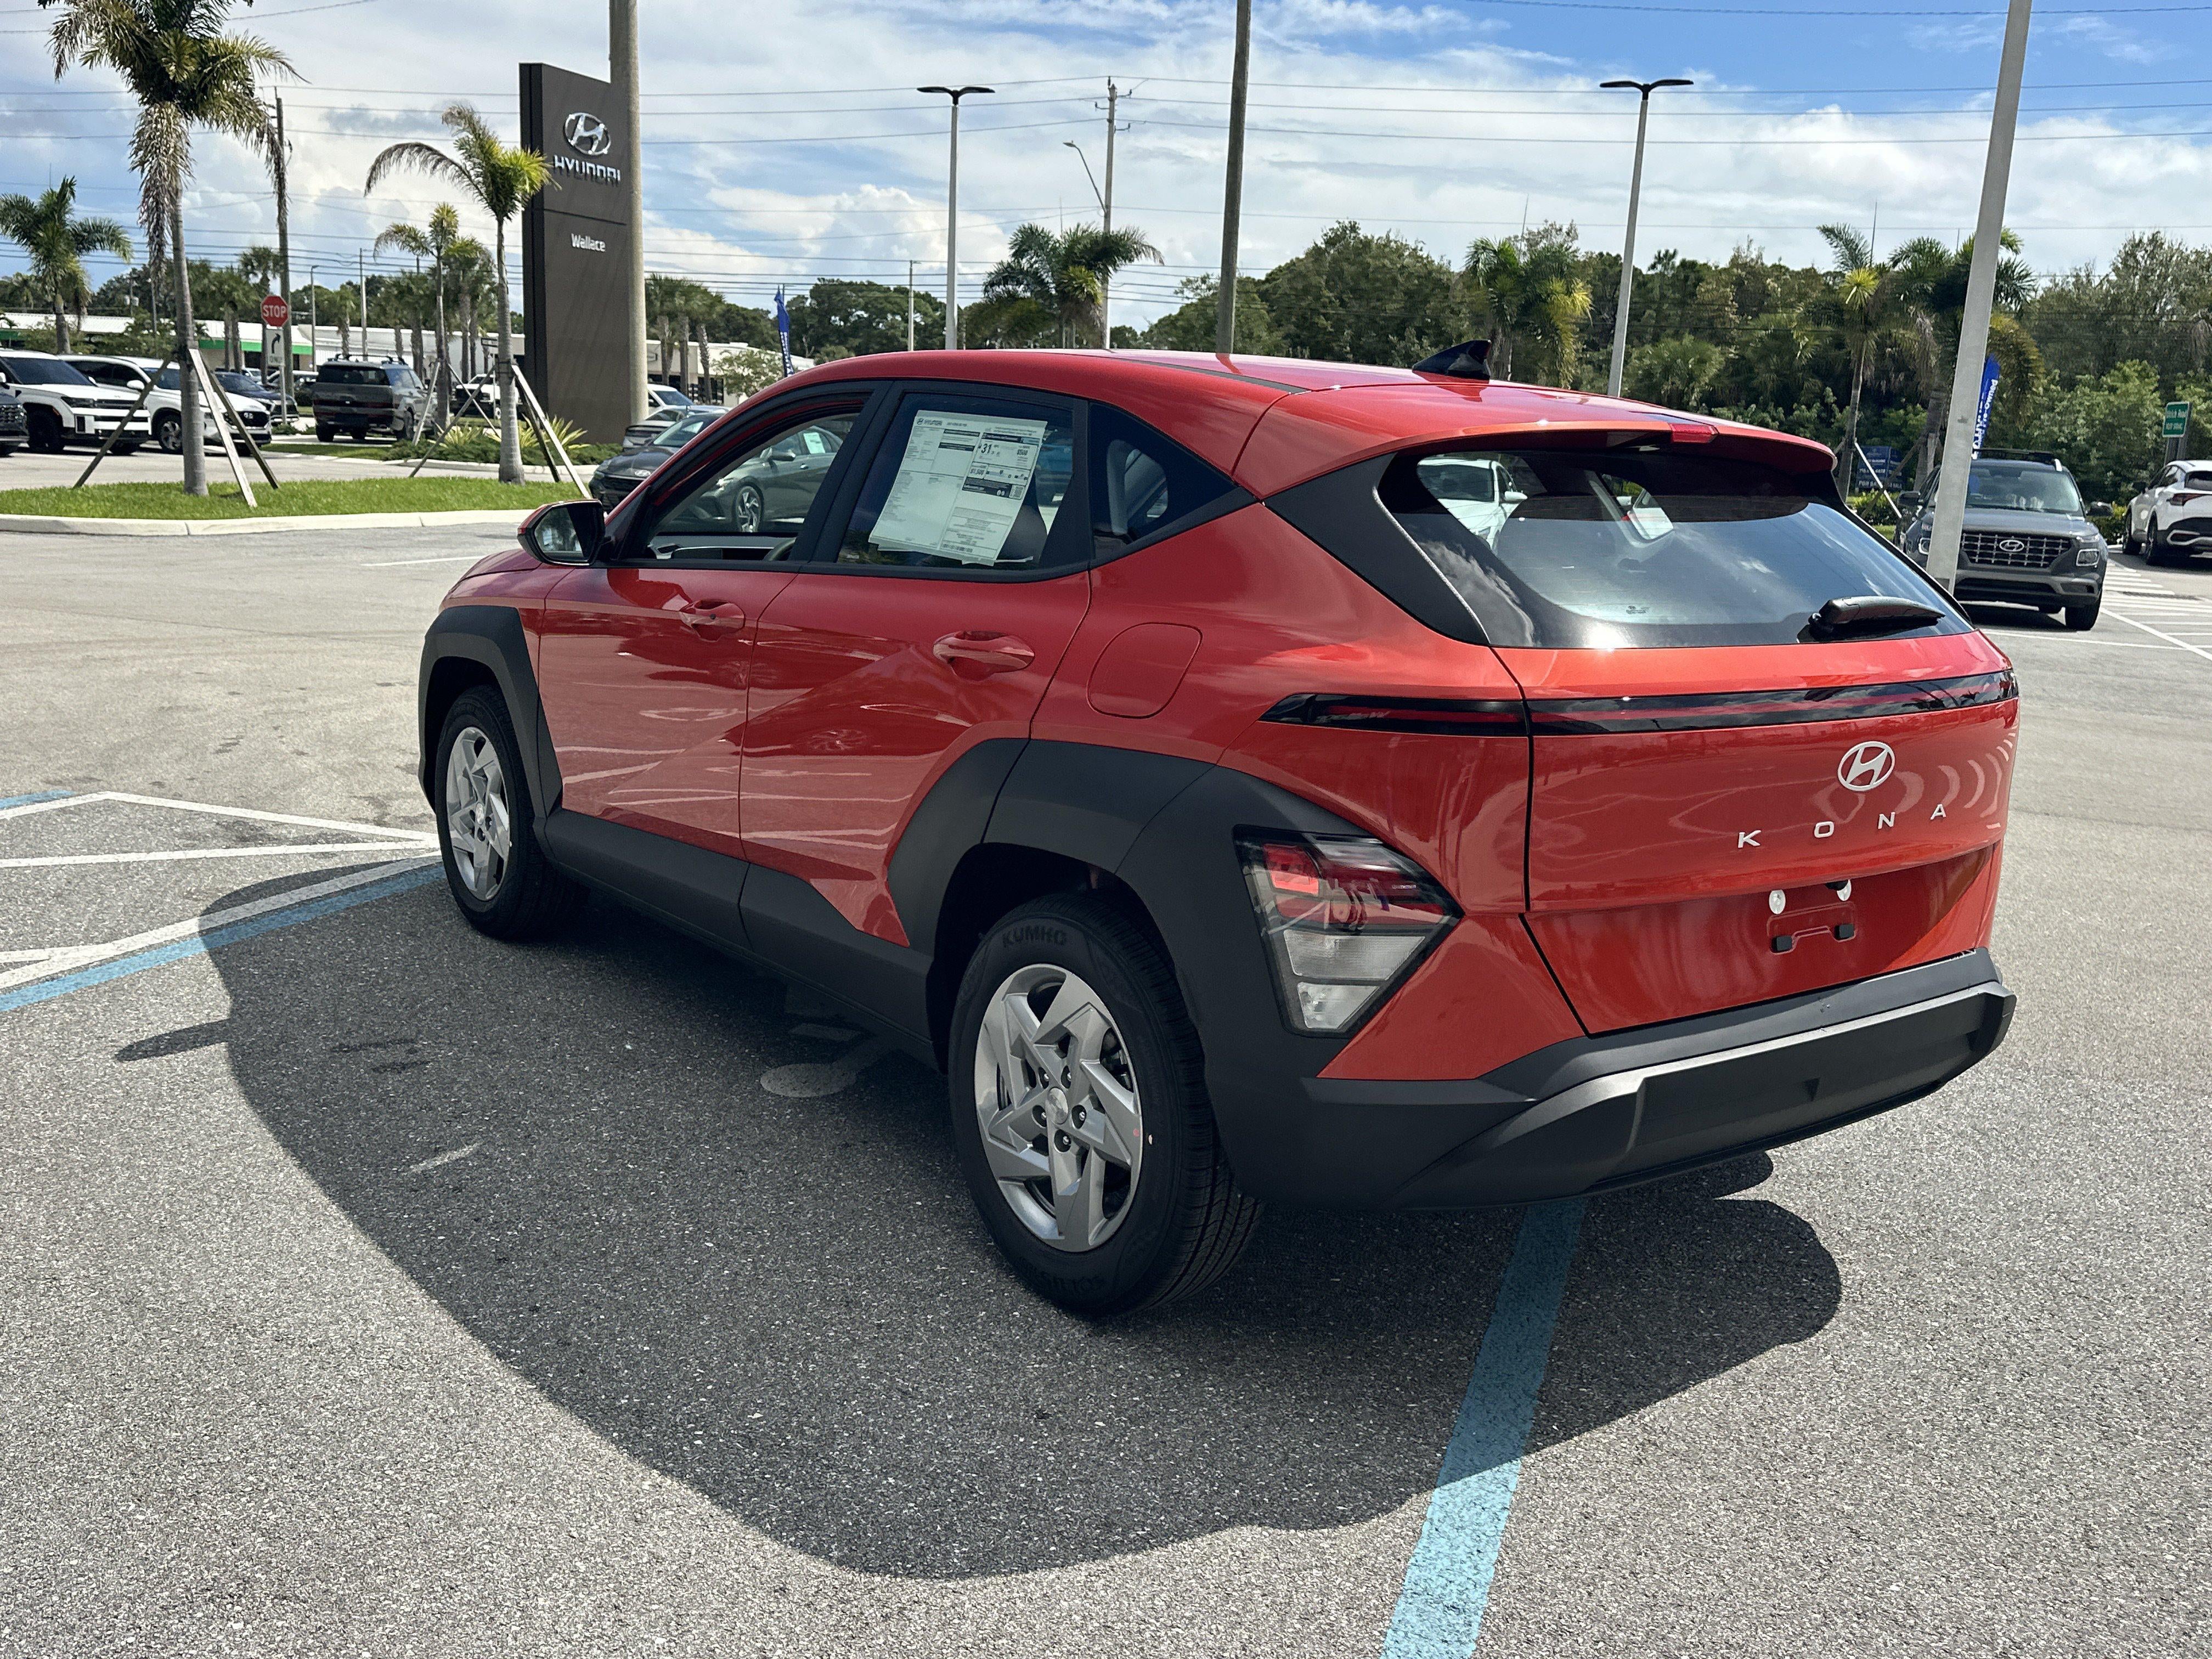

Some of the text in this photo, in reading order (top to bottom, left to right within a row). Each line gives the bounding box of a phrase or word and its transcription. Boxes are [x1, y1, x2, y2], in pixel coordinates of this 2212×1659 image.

[554, 155, 621, 182] HYUNDAI
[571, 233, 606, 252] Wallace
[263, 305, 286, 318] STOP
[1737, 803, 1946, 849] KONA
[1003, 925, 1067, 948] KUMHO
